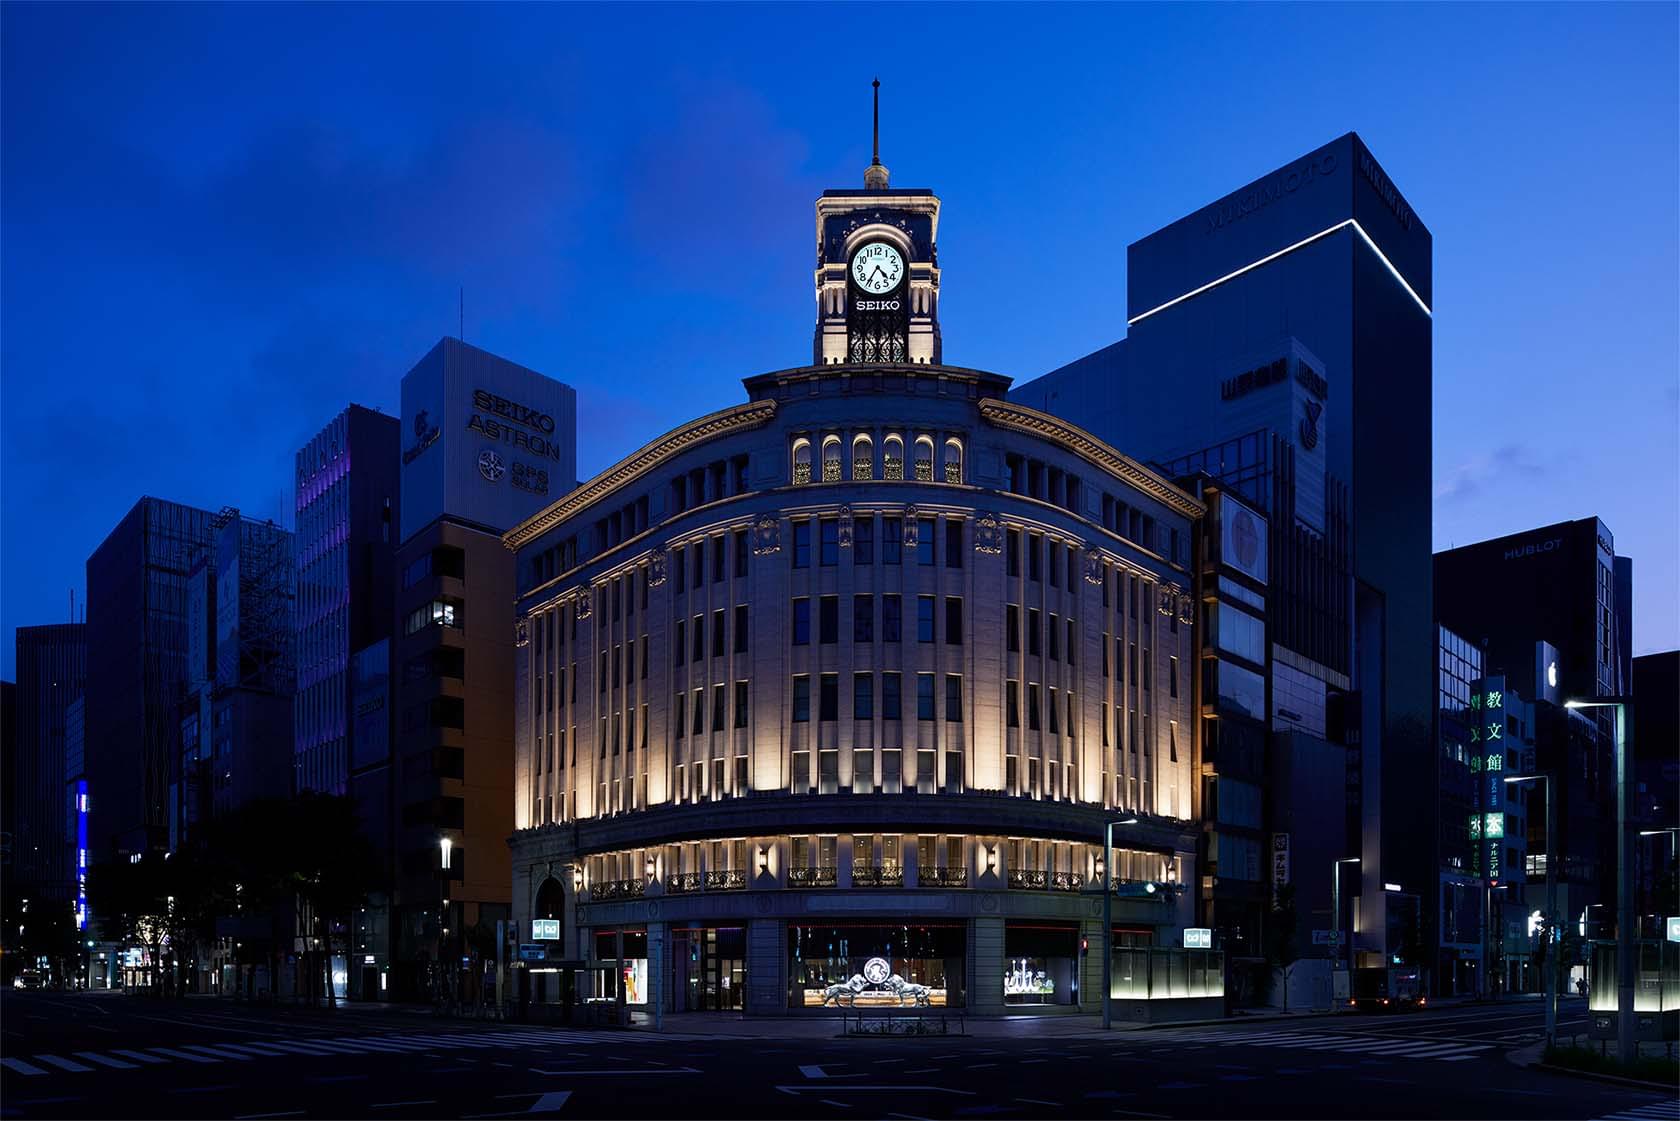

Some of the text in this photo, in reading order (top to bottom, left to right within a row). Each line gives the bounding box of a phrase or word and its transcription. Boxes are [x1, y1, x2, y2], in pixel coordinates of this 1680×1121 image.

[866, 249, 873, 257] 11
[874, 247, 882, 255] 12
[859, 256, 867, 264] 10
[890, 255, 896, 264] 2
[856, 264, 863, 273] 9
[893, 264, 899, 273] 3
[860, 273, 866, 281] 8
[889, 273, 896, 281] 4
[874, 281, 881, 289] 6
[883, 279, 889, 287] 5
[856, 301, 900, 310] SEIKO
[472, 389, 555, 432] SEIKO
[469, 414, 560, 463] ASTRON
[512, 461, 548, 483] GPS
[1504, 537, 1563, 560] HUBLOT
[1487, 691, 1502, 771] 教文館
